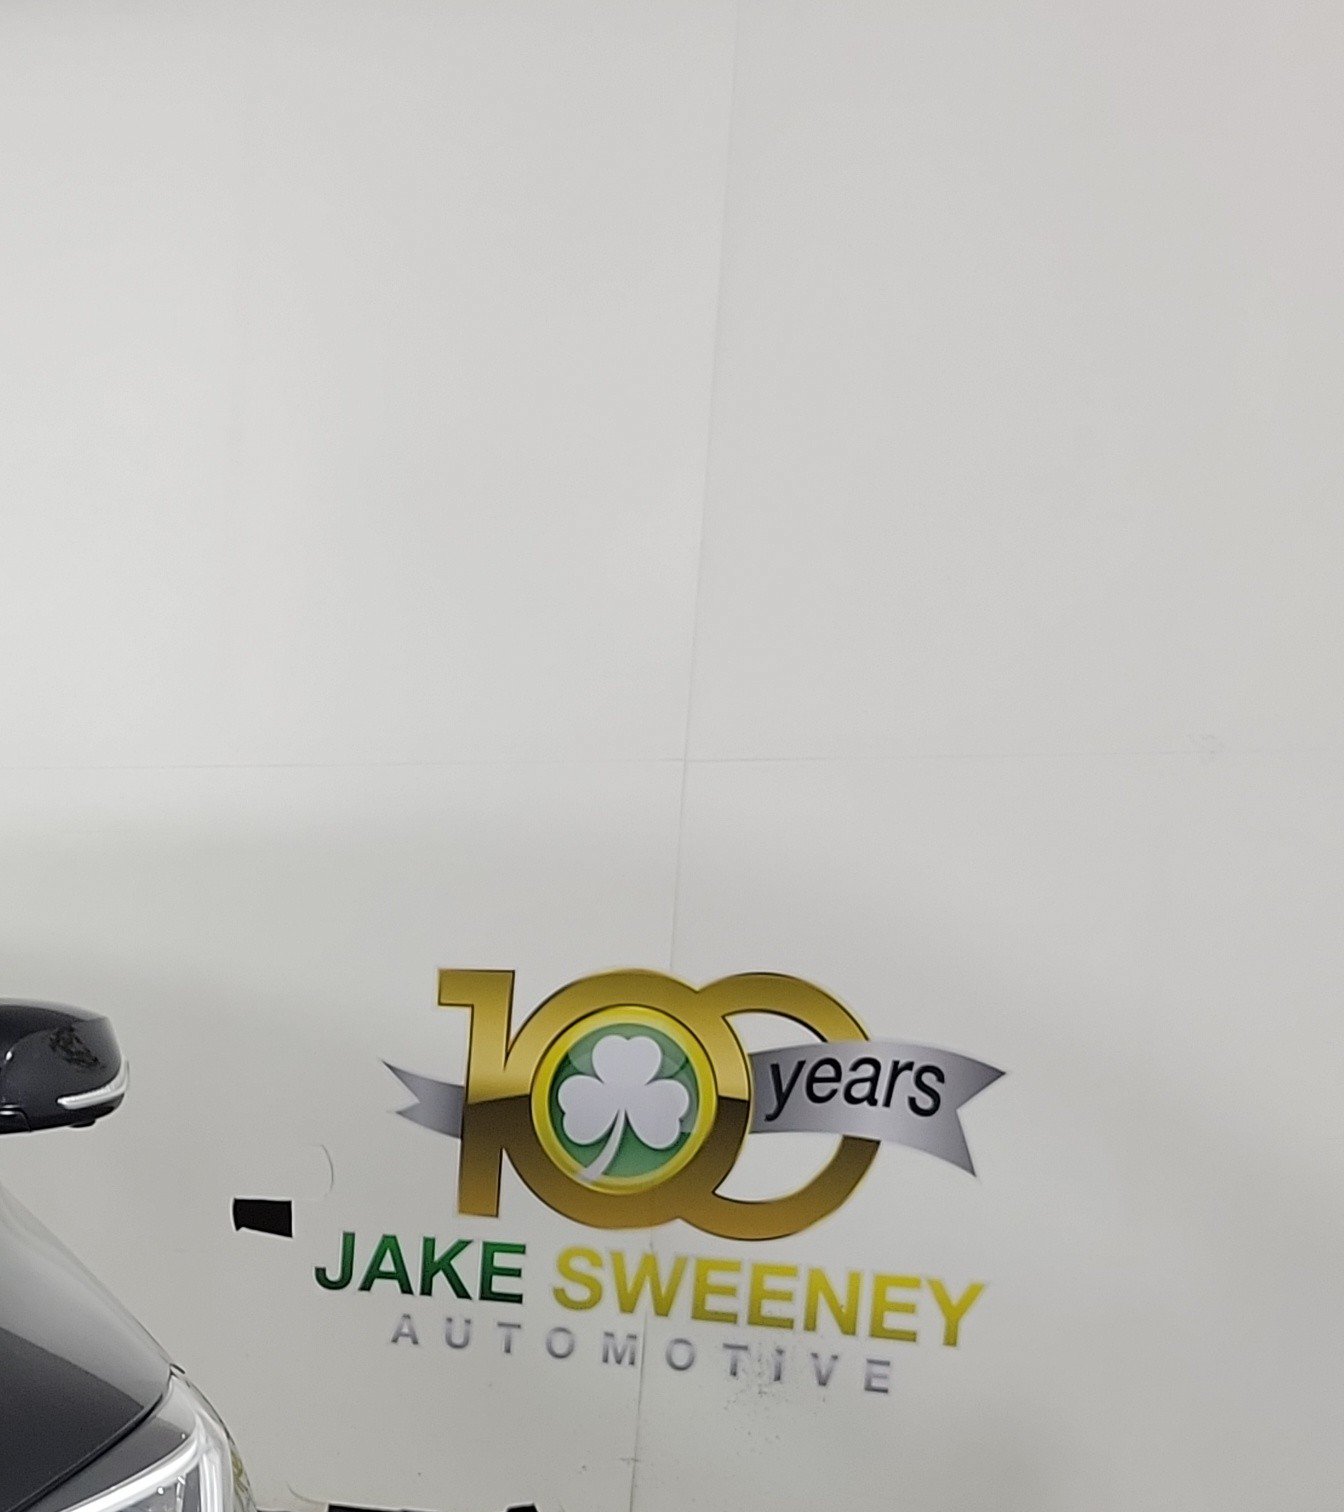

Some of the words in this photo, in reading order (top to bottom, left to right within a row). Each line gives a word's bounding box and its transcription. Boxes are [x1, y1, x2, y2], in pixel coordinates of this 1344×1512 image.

[765, 1056, 947, 1122] years
[315, 1231, 526, 1304] JAKE
[553, 1246, 985, 1346] SWEENEY
[390, 1314, 892, 1394] AUTOMOTIVE
